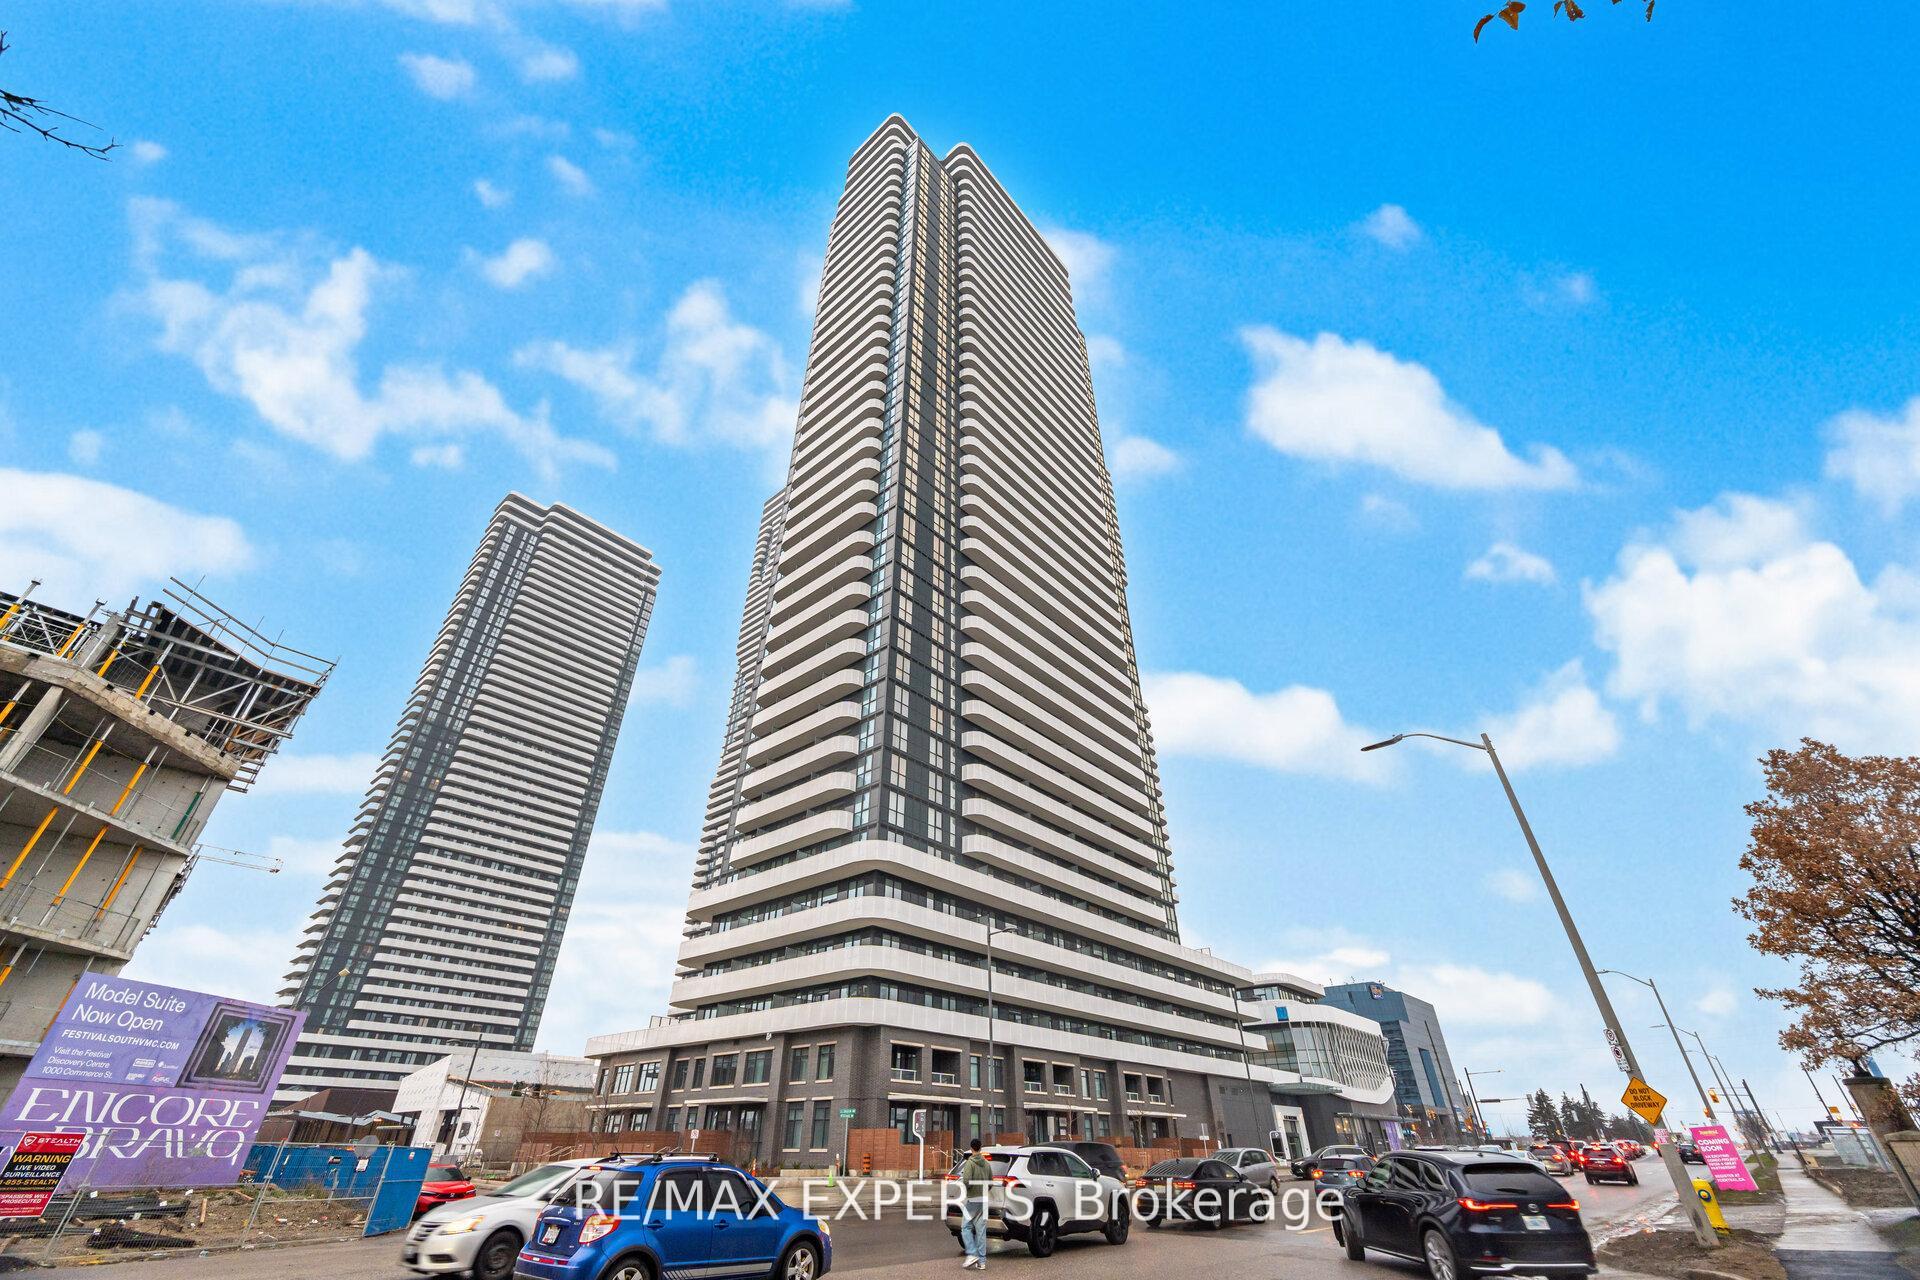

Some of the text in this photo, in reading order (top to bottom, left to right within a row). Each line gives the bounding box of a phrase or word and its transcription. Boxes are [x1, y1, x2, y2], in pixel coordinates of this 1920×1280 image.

[84, 982, 186, 1013] Model Suite
[71, 1003, 164, 1032] Now Open
[61, 1029, 180, 1050] FESTIVALSOUTHVMC.COM
[53, 1046, 112, 1059] Visit the Festival
[47, 1056, 110, 1068] Discovery Centre
[42, 1066, 113, 1079] 1000 Commerce St.
[14, 1087, 260, 1128] ENCORE
[1630, 1101, 1660, 1109] DRIVEWAY
[1697, 1138, 1730, 1146] COMING
[13, 1154, 72, 1163] WARNING
